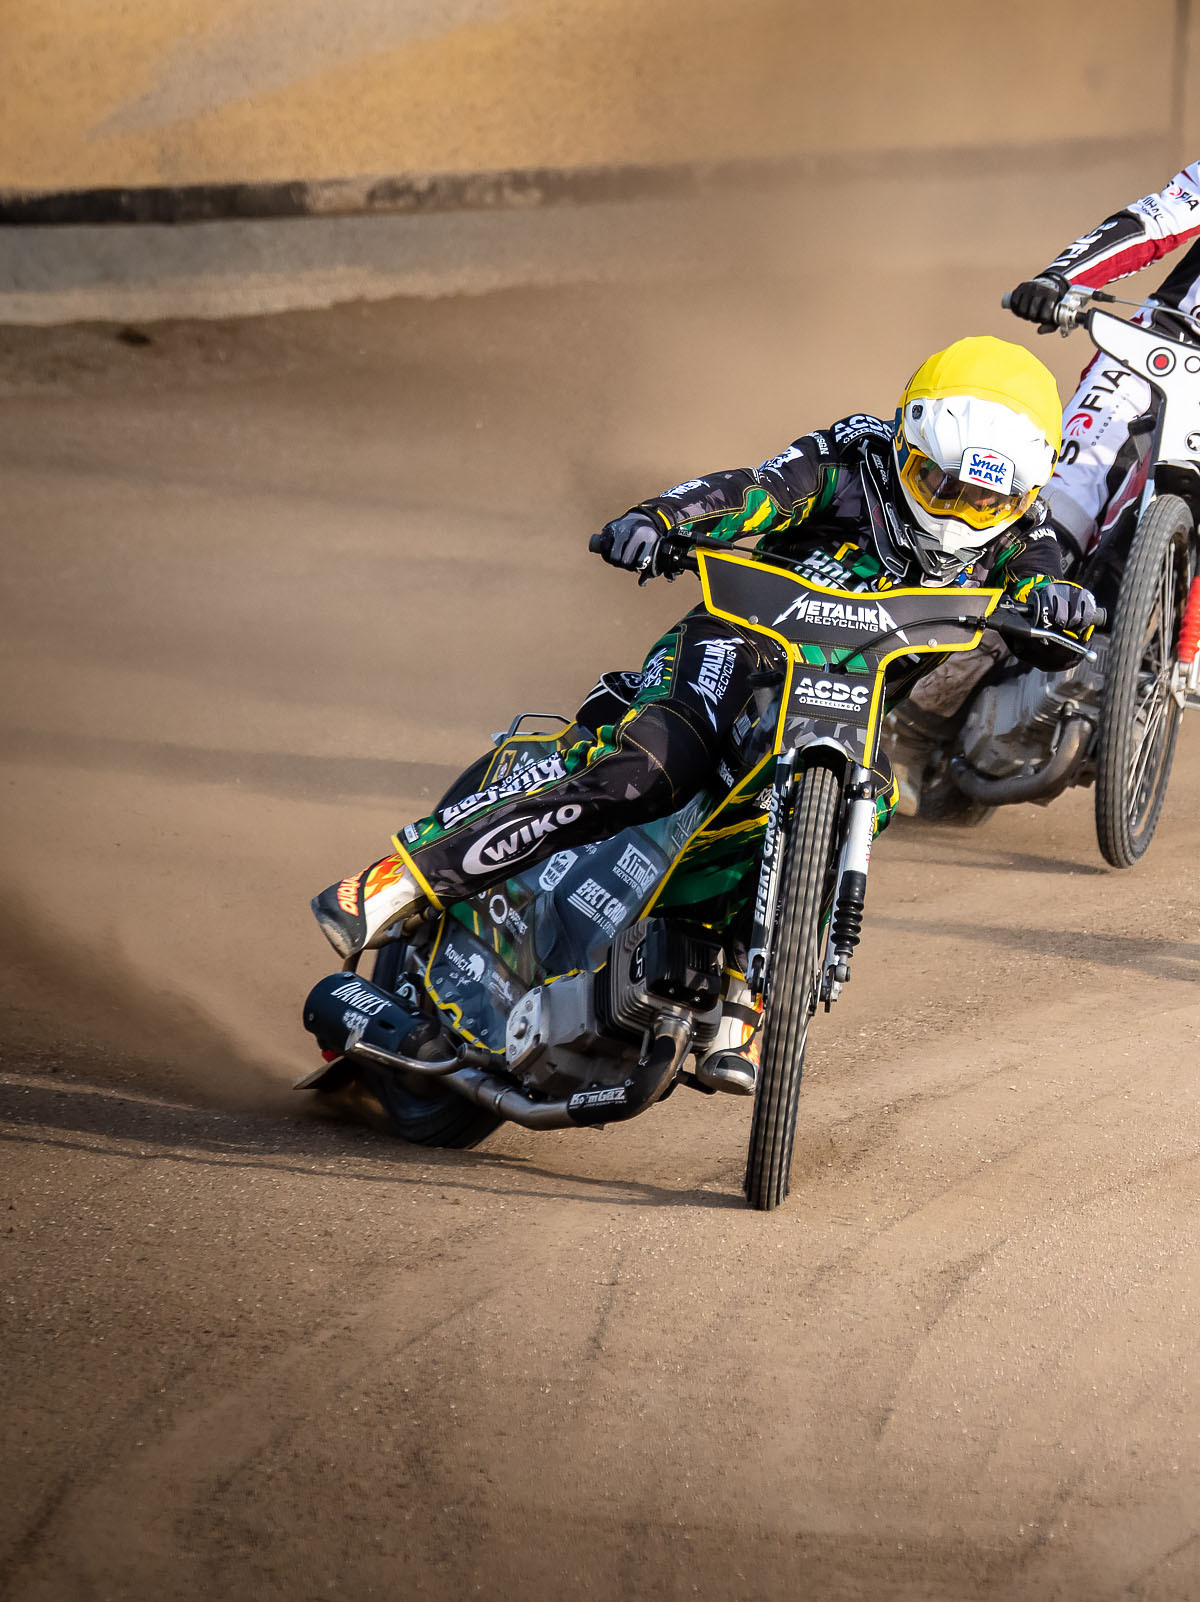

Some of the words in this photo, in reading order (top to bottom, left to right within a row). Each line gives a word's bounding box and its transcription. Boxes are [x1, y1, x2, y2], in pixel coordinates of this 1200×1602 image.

[968, 467, 1004, 485] MAK
[970, 453, 1007, 476] Smak
[772, 592, 910, 645] METALIKA
[805, 616, 879, 632] RECYCLING
[715, 651, 737, 700] RECYCLING
[794, 678, 870, 705] ACDC
[810, 699, 851, 709] RECYCLING
[484, 804, 582, 861] WIKO
